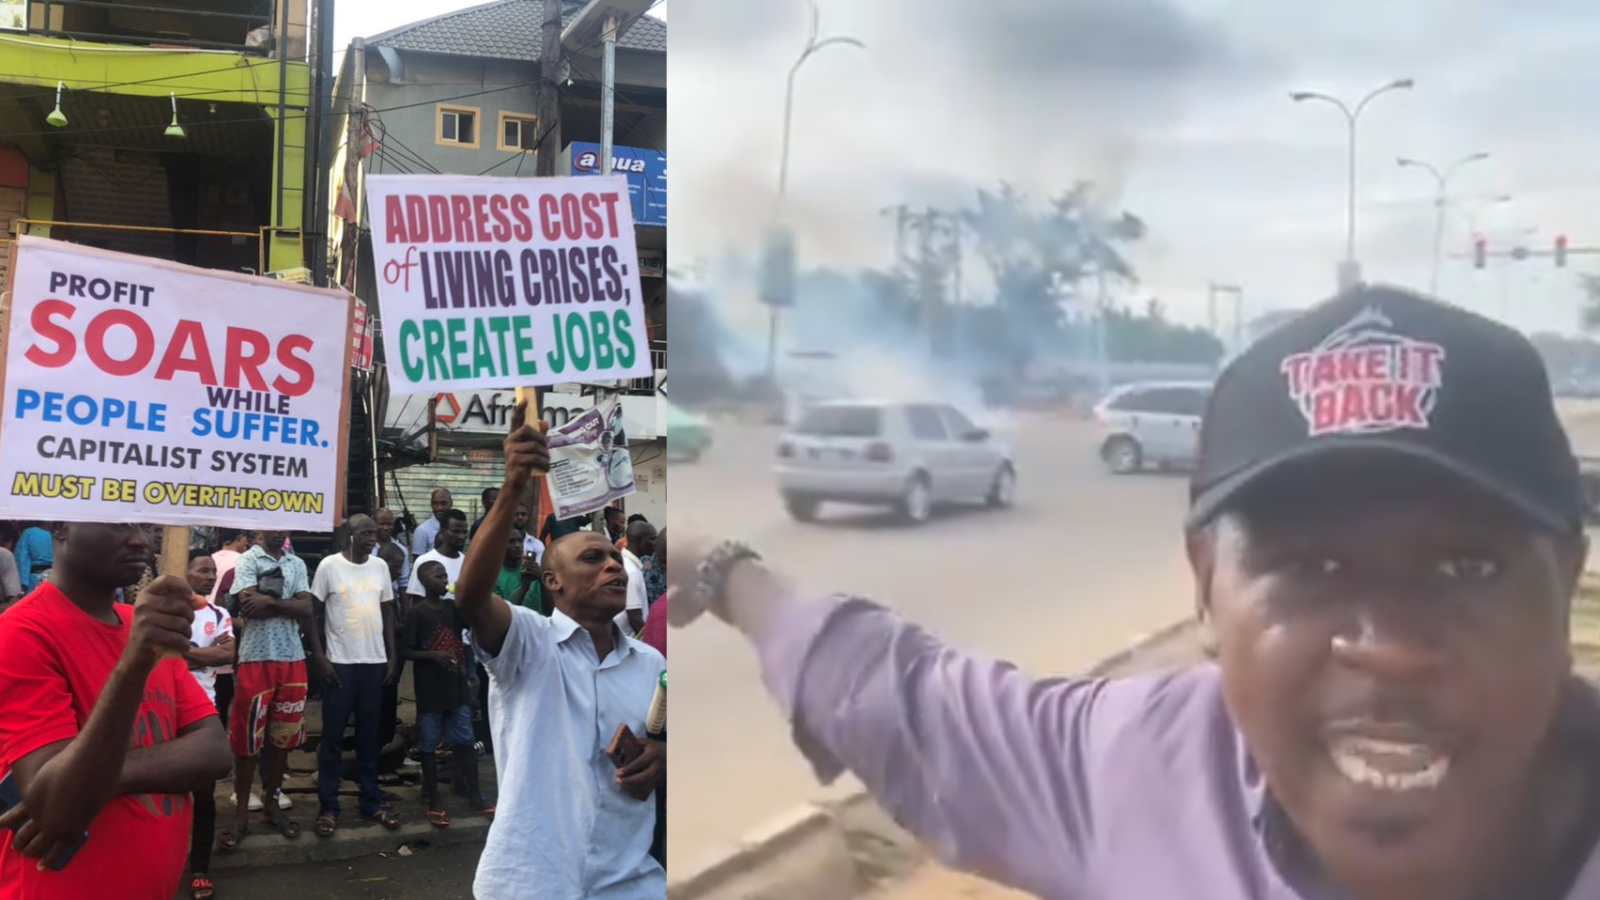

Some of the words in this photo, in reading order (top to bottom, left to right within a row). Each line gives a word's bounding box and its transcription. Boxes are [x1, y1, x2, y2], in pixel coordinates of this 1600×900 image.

[385, 194, 533, 243] ADDRESS
[538, 192, 619, 241] COST
[49, 271, 154, 307] PROFIT
[383, 246, 418, 292] of
[420, 249, 517, 309] LIVING
[520, 245, 631, 306] CRISES;
[24, 299, 315, 397] SOARS
[399, 315, 537, 383] CREATE
[547, 309, 636, 373] JOBS
[1280, 344, 1391, 399] TAKE
[1394, 343, 1445, 388] IT
[15, 389, 167, 432] PEOPLE
[191, 408, 329, 448] SUFFER.
[206, 387, 290, 415] WHILE
[1309, 380, 1429, 437] BACK
[37, 435, 202, 469] CAPITALIST
[210, 450, 308, 478] SYSTEM
[11, 472, 95, 499] MUST
[102, 478, 136, 501] BE
[143, 481, 324, 513] OVERTHROWN
